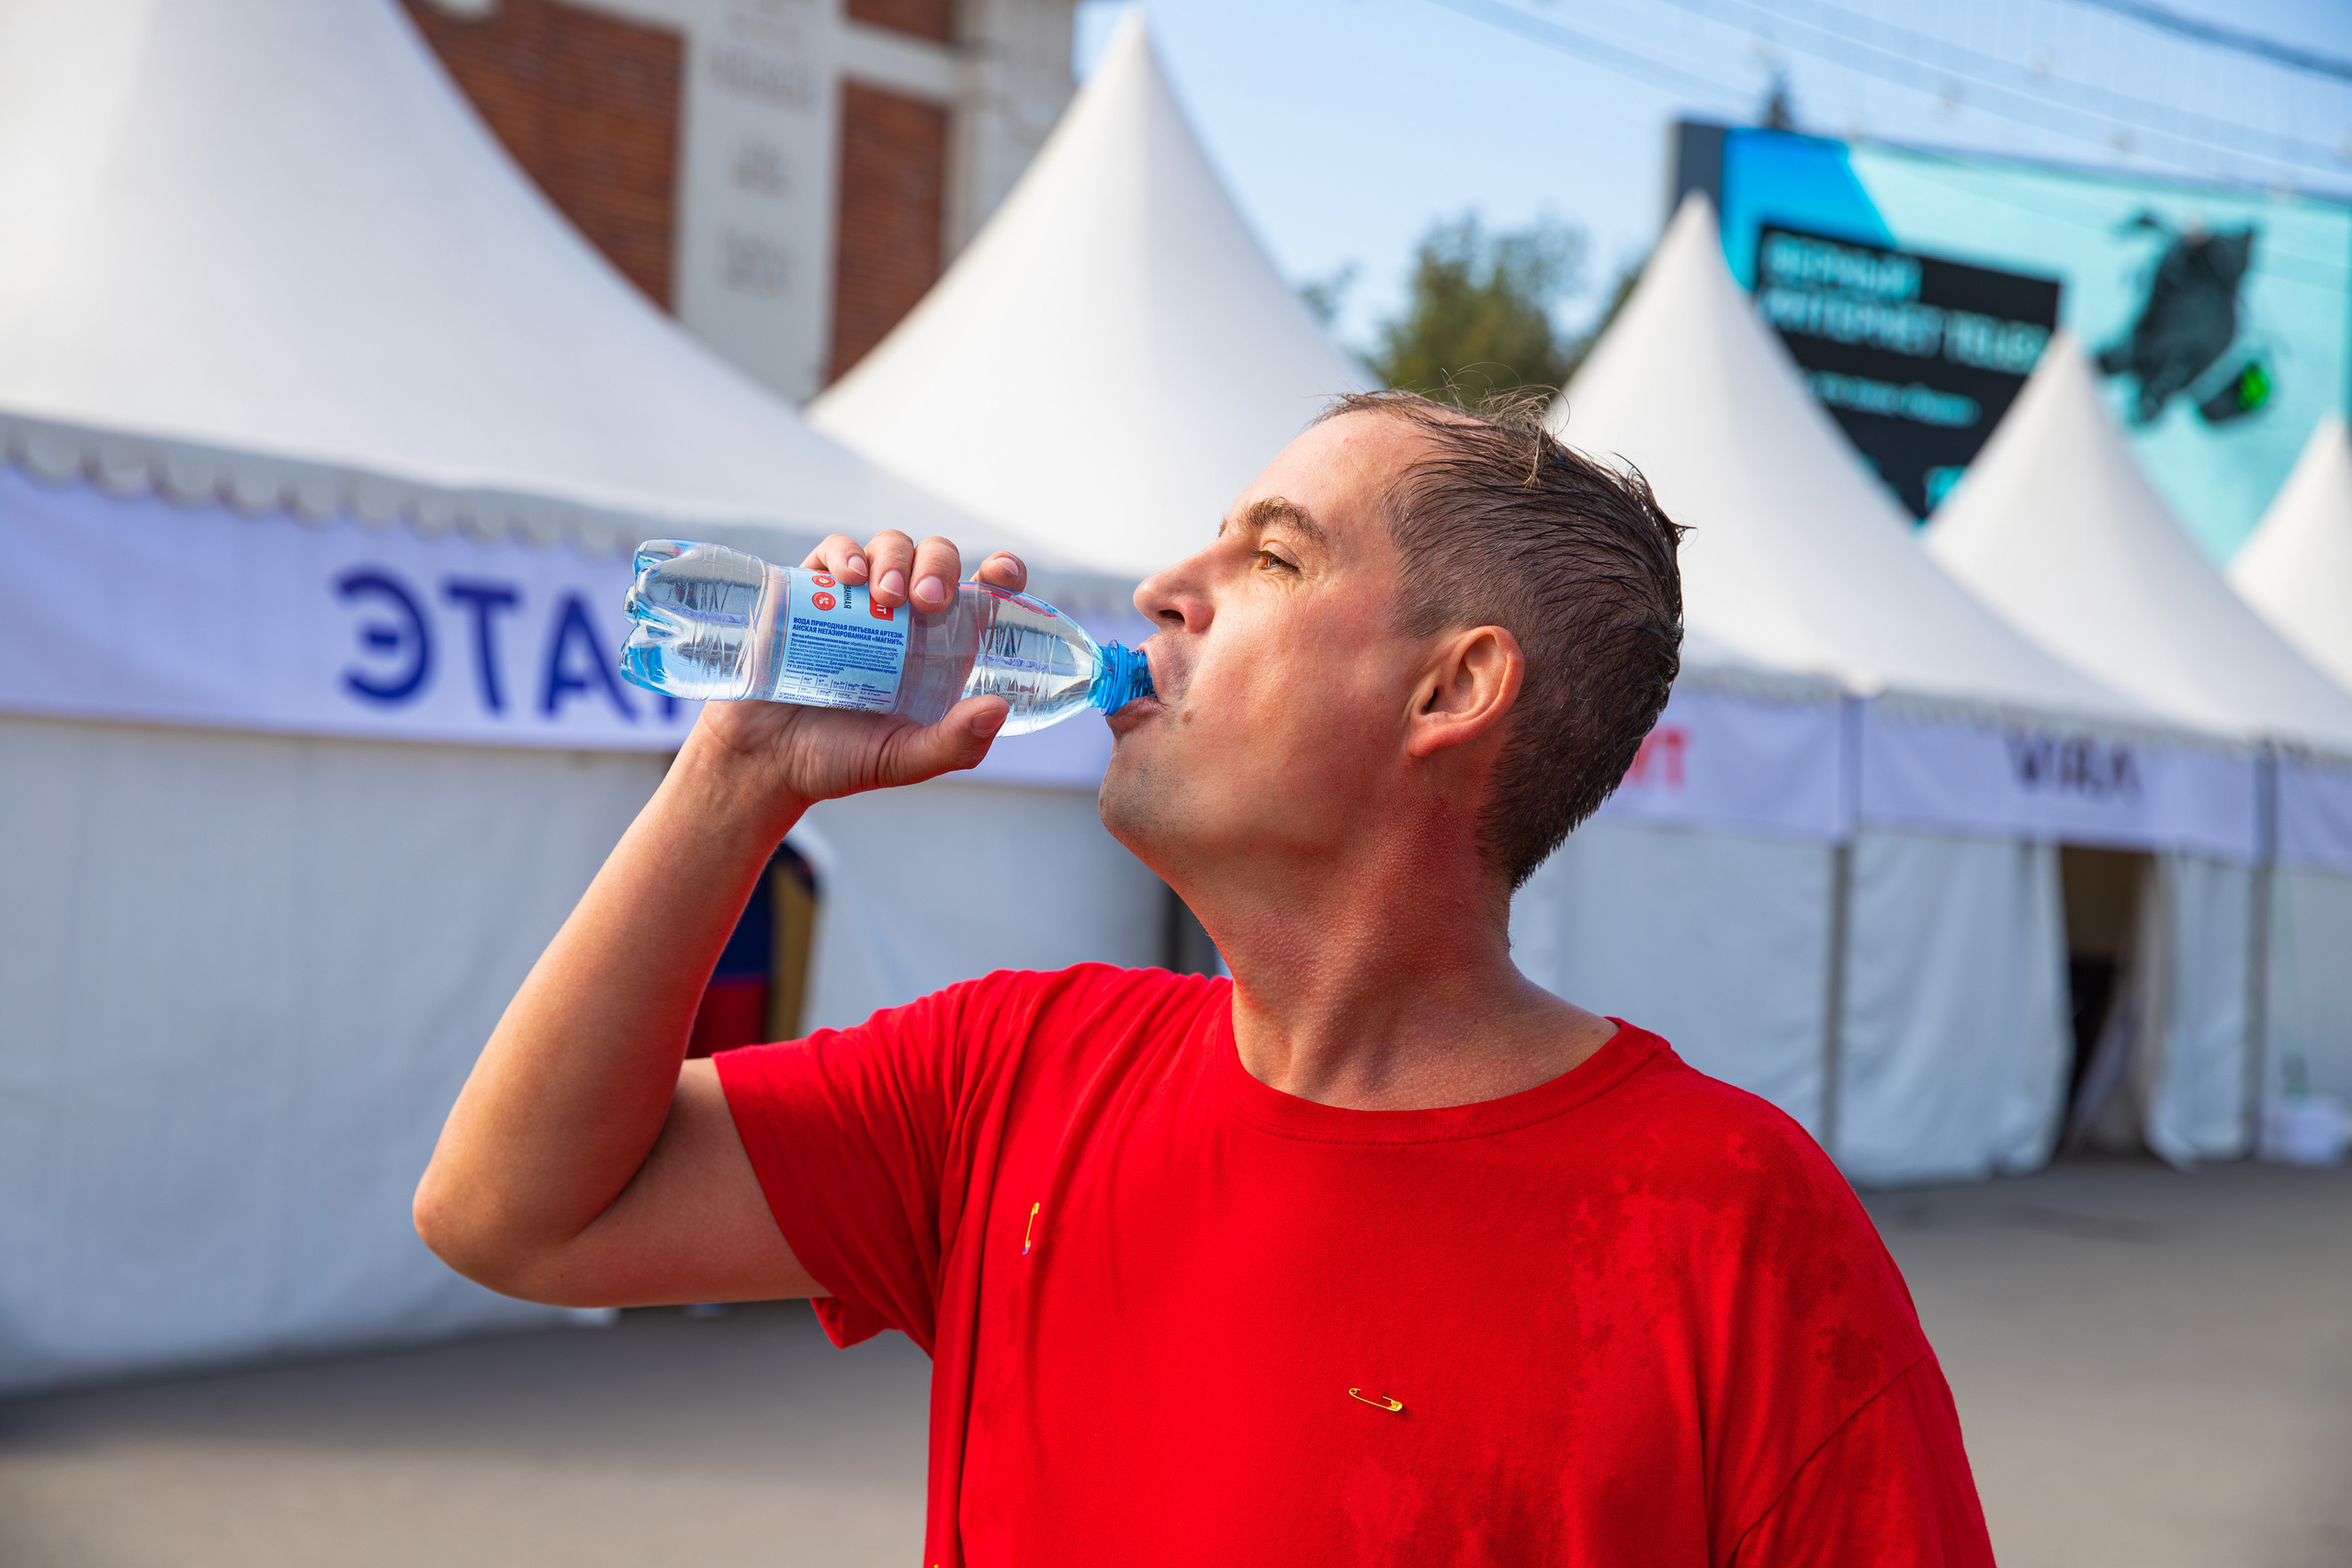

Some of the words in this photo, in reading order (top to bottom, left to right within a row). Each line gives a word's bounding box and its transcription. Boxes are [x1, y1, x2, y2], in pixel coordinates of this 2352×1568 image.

[793, 624, 817, 633] АНСКАЯ
[818, 627, 871, 641] НЕГАЗИРОВАННАЯ
[794, 617, 810, 626] ВОДА
[811, 619, 847, 631] ПРИРОДНАЯ
[849, 625, 878, 636] ПИТЬЕВАЯ
[880, 629, 904, 639] АРТЕЗИ-
[334, 564, 679, 723] ЭТА
